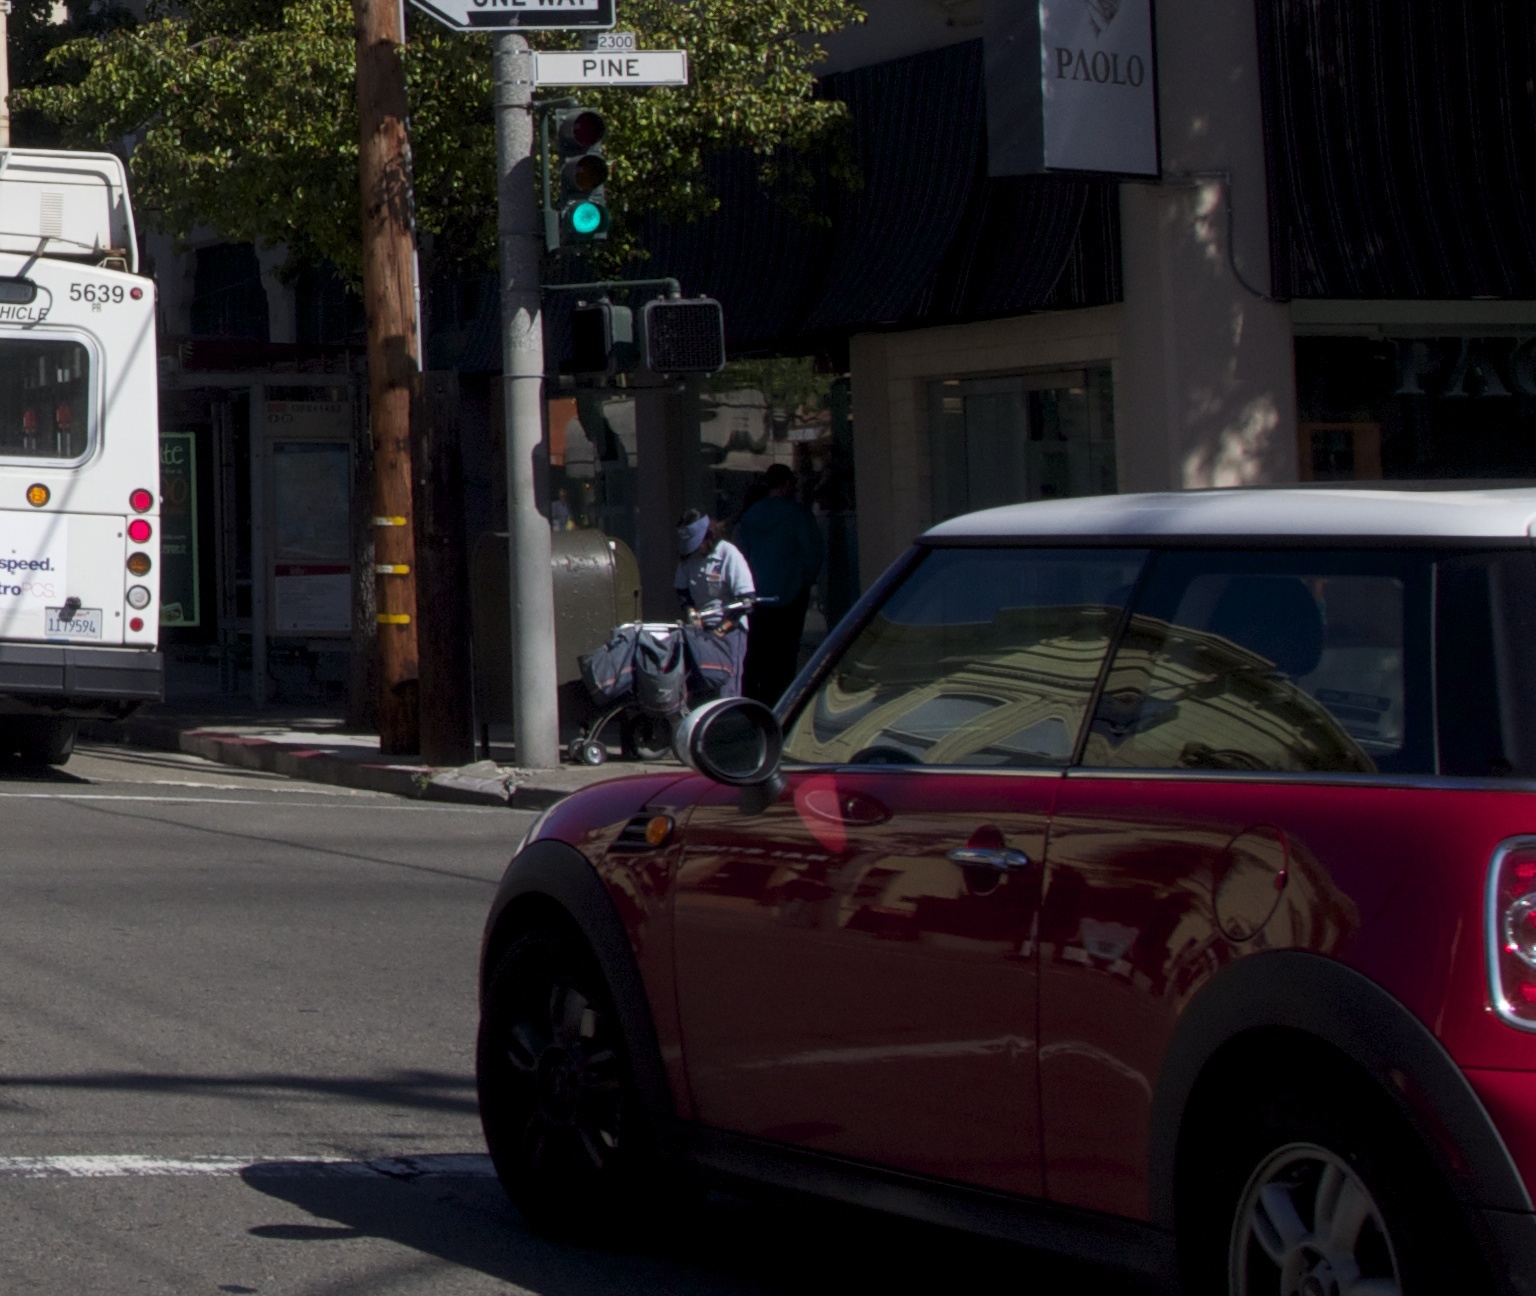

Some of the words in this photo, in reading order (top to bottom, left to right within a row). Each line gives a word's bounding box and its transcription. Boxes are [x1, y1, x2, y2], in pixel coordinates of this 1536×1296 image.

[599, 36, 633, 49] 2300
[583, 59, 640, 77] PINE
[1055, 47, 1145, 88] PAOLO
[69, 283, 125, 303] 5639
